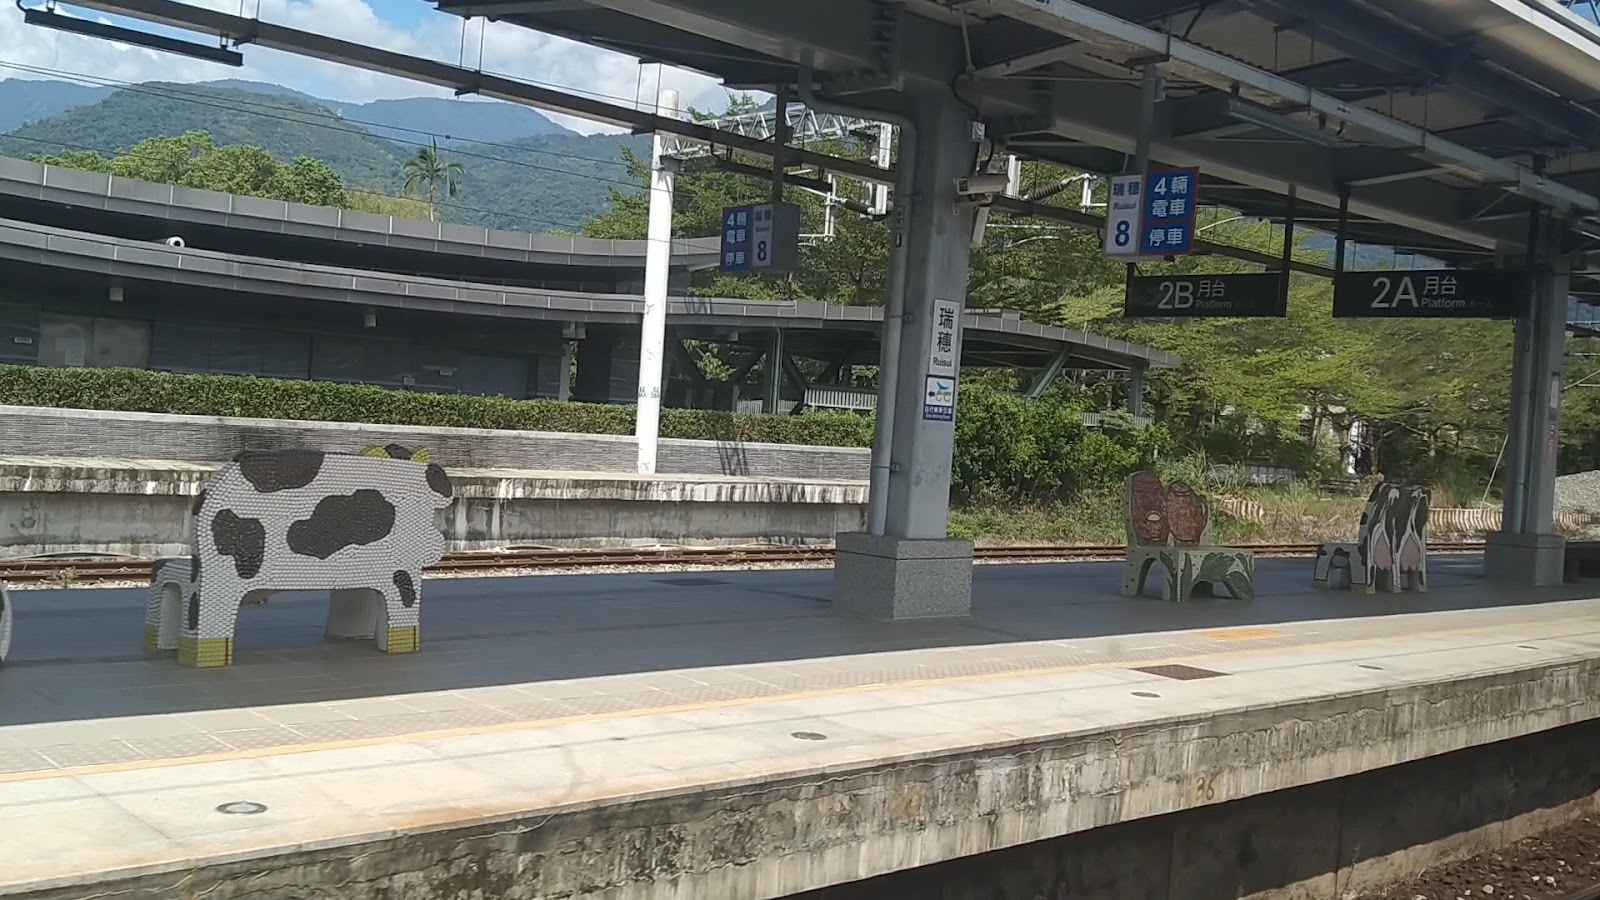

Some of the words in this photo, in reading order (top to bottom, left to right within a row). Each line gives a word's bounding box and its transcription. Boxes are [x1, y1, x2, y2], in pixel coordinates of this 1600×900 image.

[1113, 181, 1140, 196] 瑞穗
[1152, 198, 1186, 218] 電車
[727, 230, 746, 243] 電車
[1114, 220, 1130, 247] 8
[1149, 228, 1183, 247] 停車
[726, 252, 745, 266] 停車
[757, 240, 767, 262] 8
[1157, 281, 1194, 310] 2B
[1197, 279, 1226, 298] 月台
[1370, 276, 1419, 308] 2A
[1422, 275, 1458, 295] 月台
[1196, 299, 1232, 309] Platform
[1421, 297, 1466, 308] Platform
[937, 307, 954, 353] 瑞穗
[933, 357, 952, 367] Ruisui
[1196, 777, 1215, 801] 36
